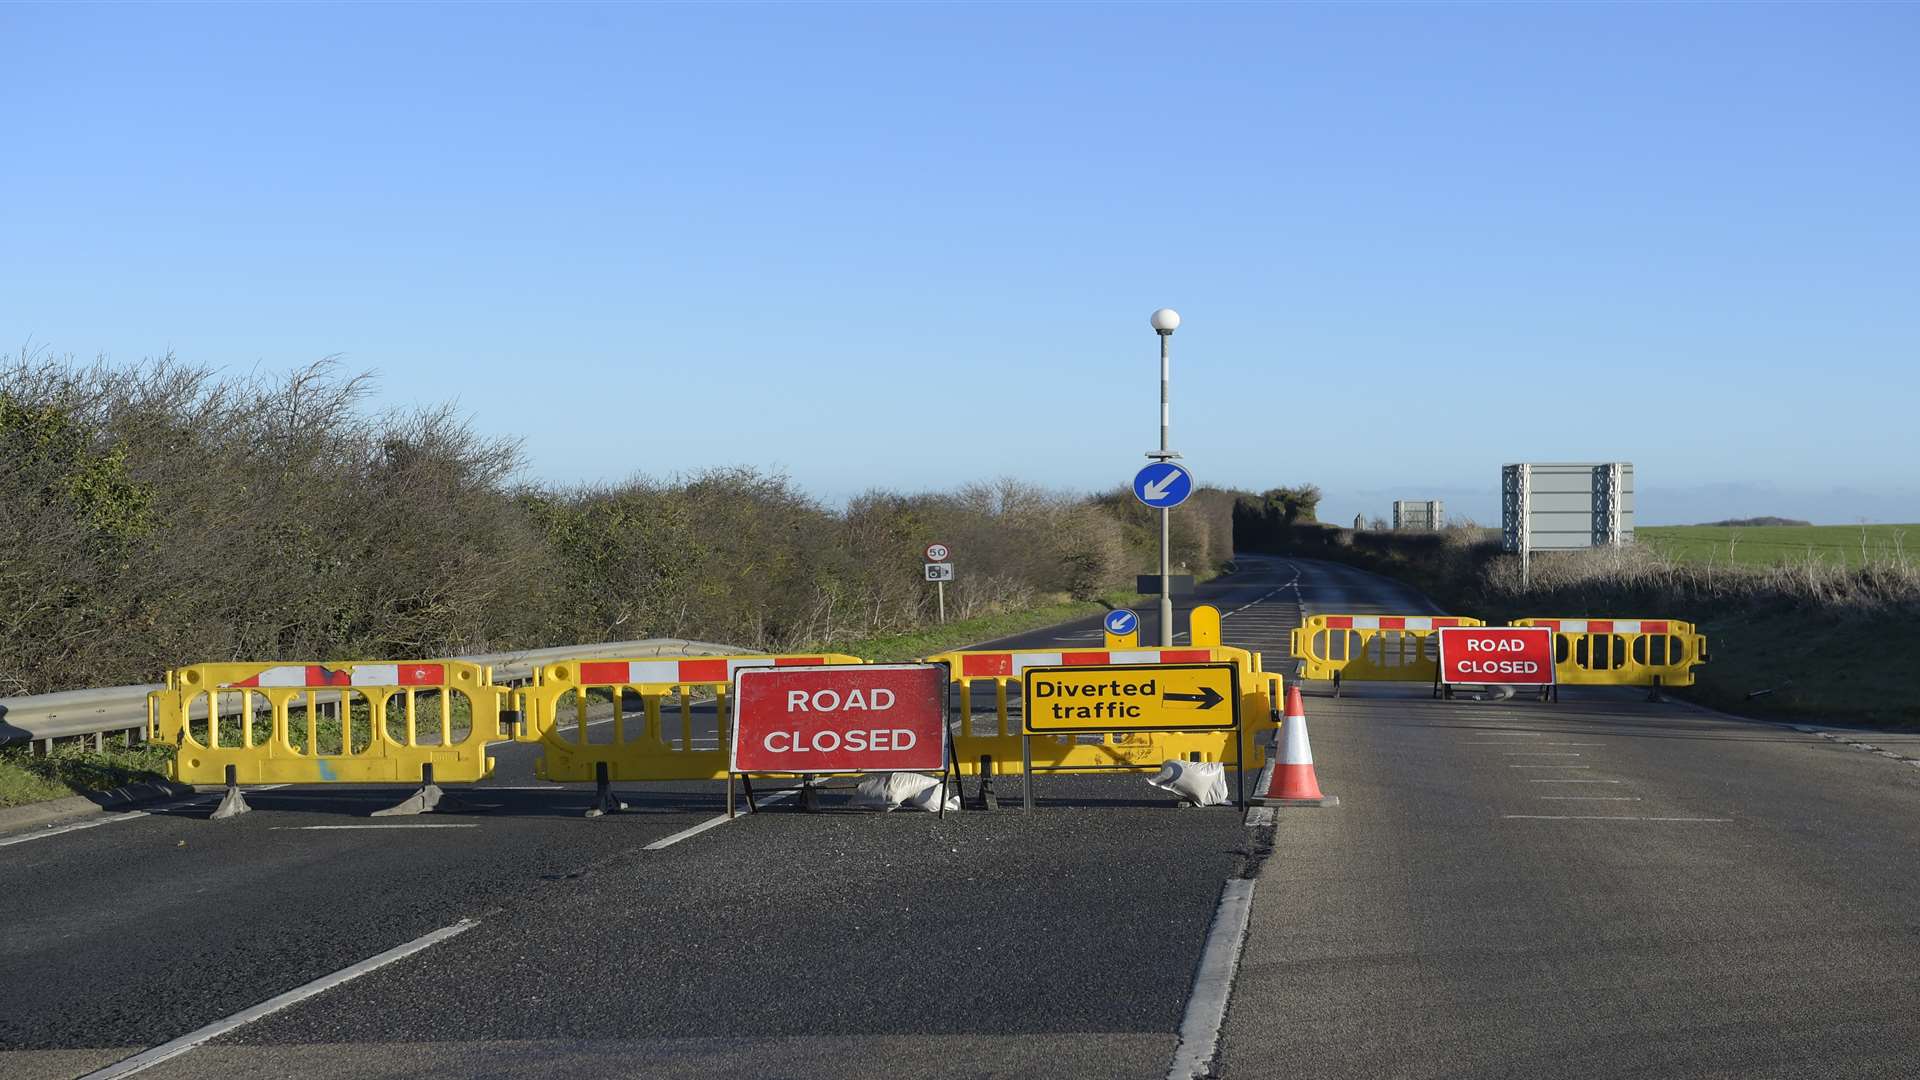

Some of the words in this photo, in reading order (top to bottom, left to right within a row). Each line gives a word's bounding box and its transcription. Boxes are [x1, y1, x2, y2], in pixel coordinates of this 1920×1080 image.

[929, 548, 945, 557] 50
[1467, 639, 1525, 652] ROAD
[1457, 660, 1538, 674] CLOSED
[1036, 679, 1156, 698] Diverted
[787, 688, 896, 713] ROAD
[1052, 701, 1141, 719] traffic
[763, 729, 917, 753] CLOSED
